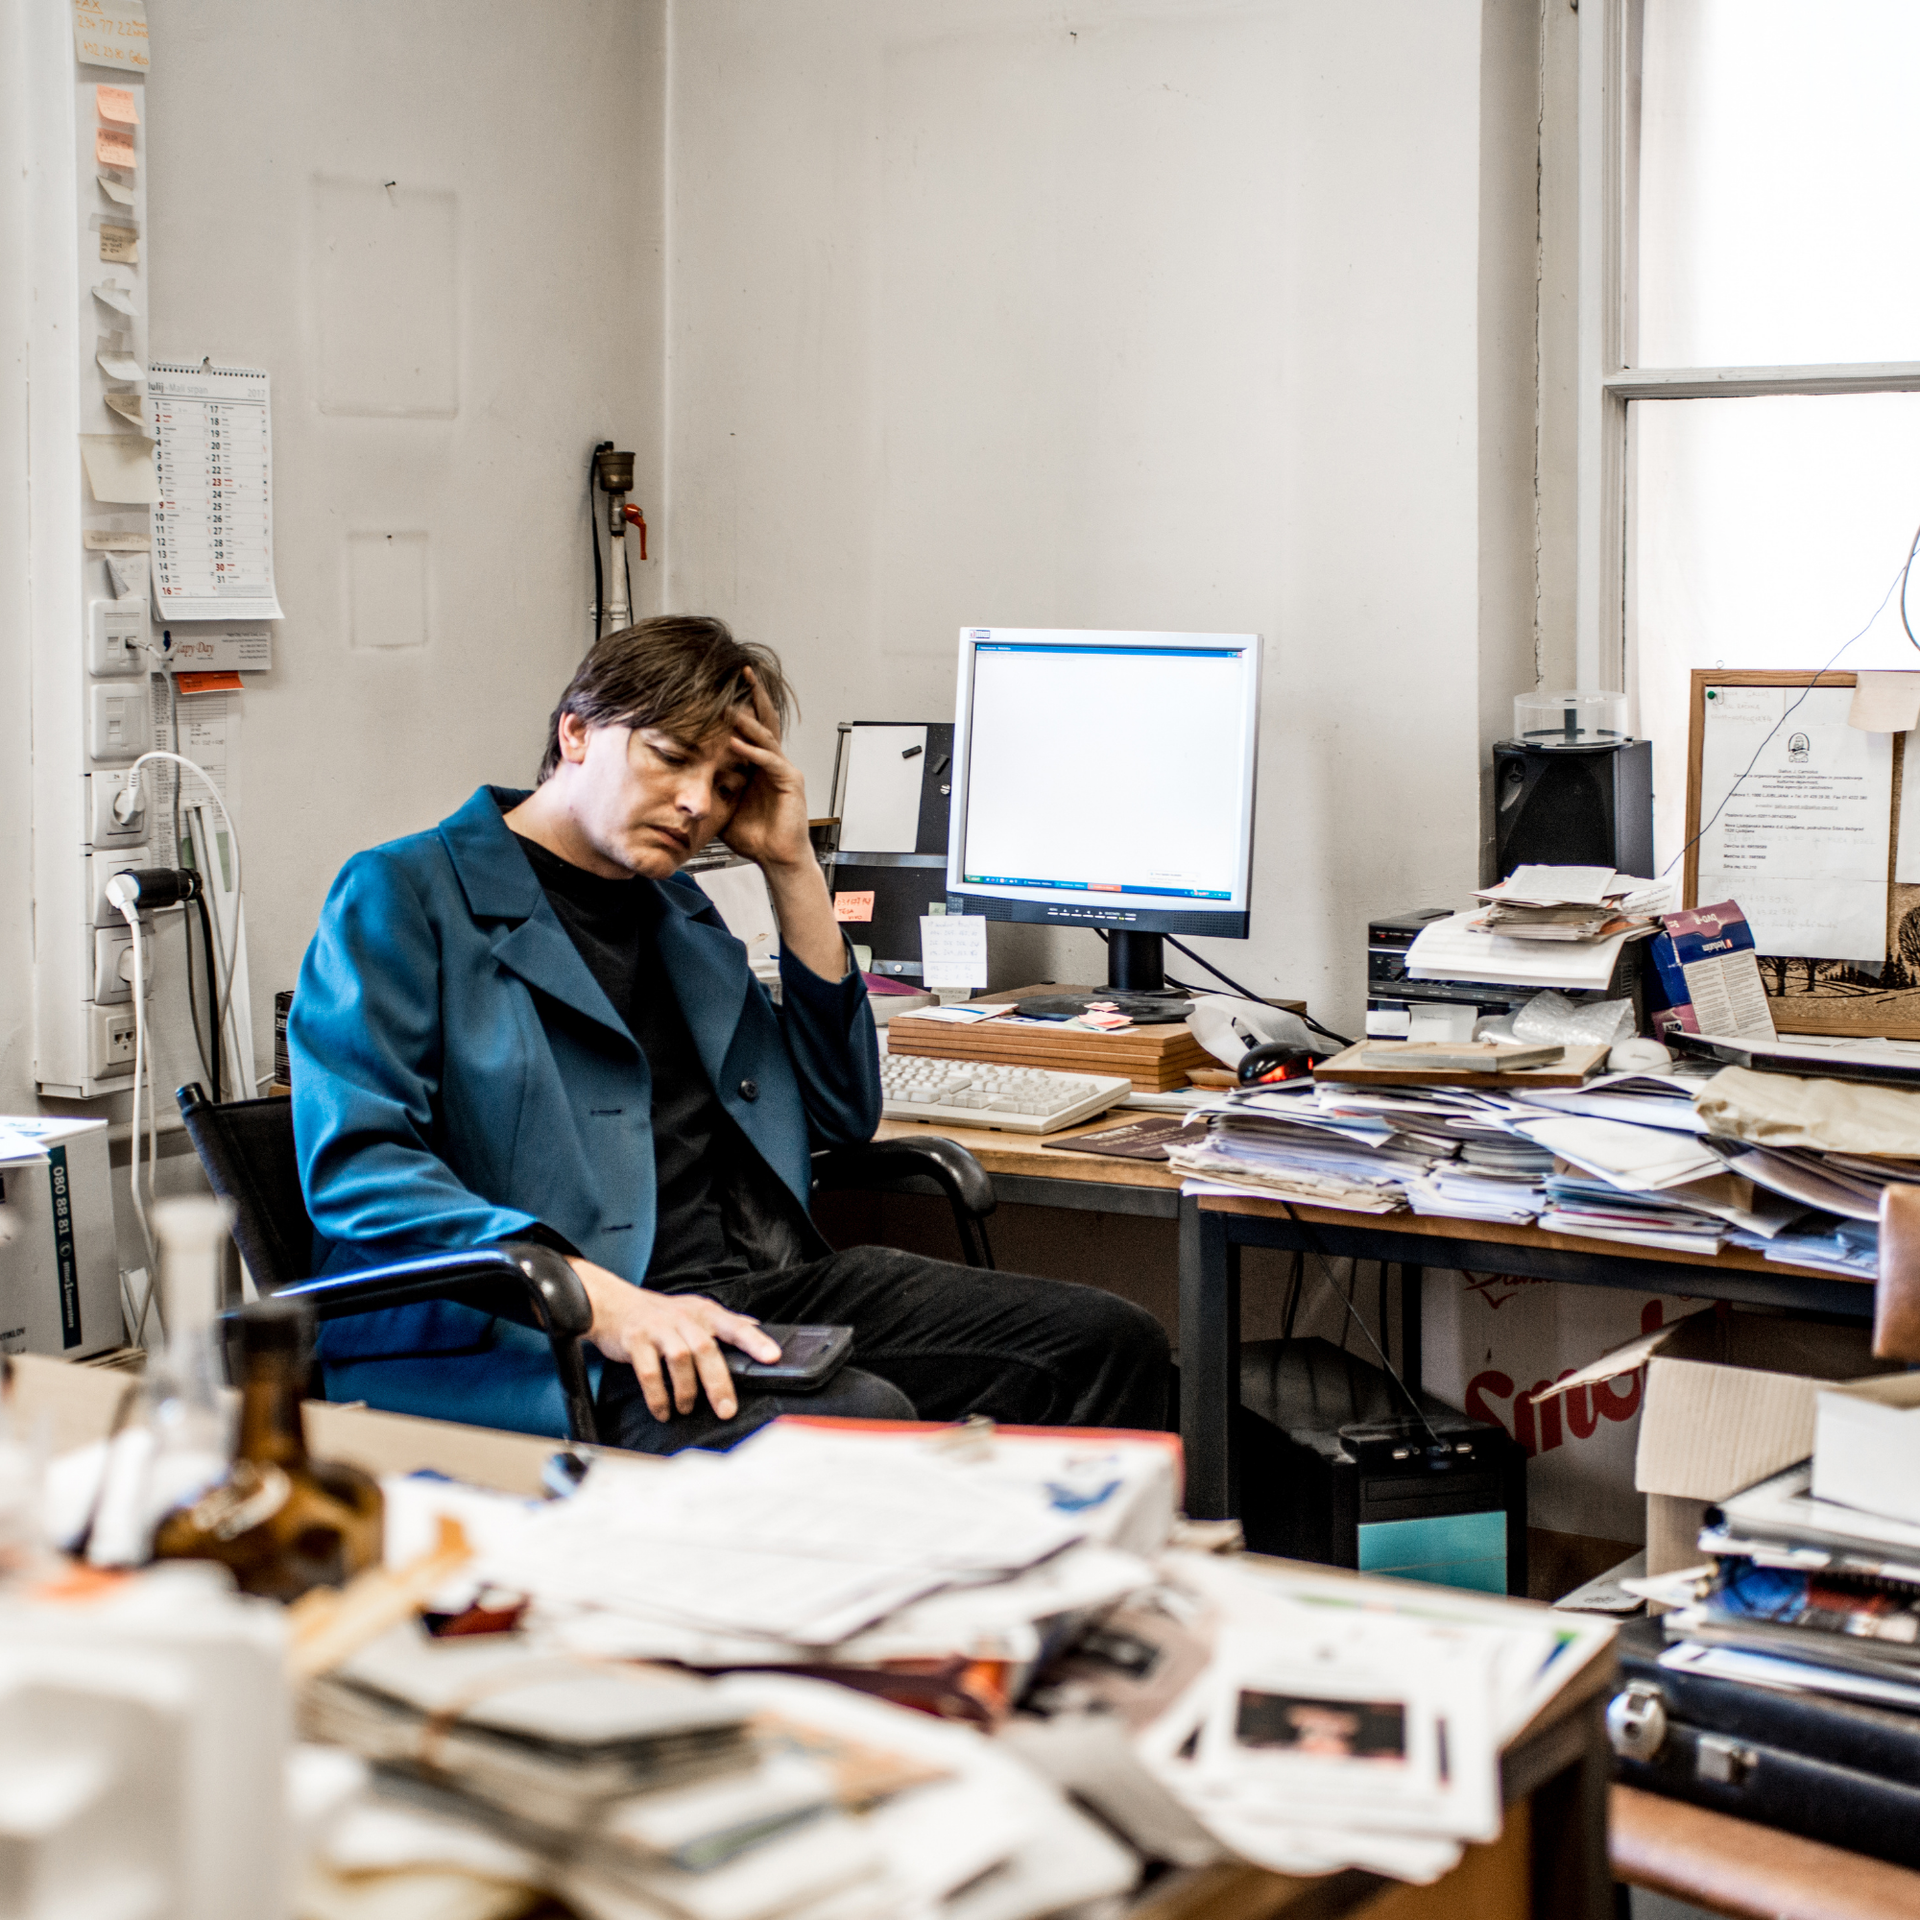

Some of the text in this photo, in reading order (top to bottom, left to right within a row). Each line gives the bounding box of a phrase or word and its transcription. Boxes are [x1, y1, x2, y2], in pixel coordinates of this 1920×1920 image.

[247, 389, 265, 398] 2017
[155, 401, 160, 410] 1
[210, 405, 219, 413] 17
[155, 413, 161, 423] 2
[210, 418, 220, 426] 18
[156, 426, 161, 435] 3
[211, 430, 220, 438] 19
[211, 442, 220, 450] 20
[157, 451, 162, 460] 5
[211, 454, 220, 462] 21
[157, 464, 163, 472] 6
[212, 466, 221, 475] 22
[212, 478, 222, 487] 23
[212, 490, 222, 499] 24
[159, 501, 164, 509] 9
[212, 503, 222, 511] 25
[155, 513, 165, 522] 10
[213, 515, 222, 523] 26
[155, 525, 165, 534] 11
[213, 527, 222, 535] 27
[156, 538, 166, 546] 12
[214, 539, 223, 547] 28
[157, 550, 167, 559] 13
[215, 551, 224, 560] 29
[159, 562, 168, 571] 14
[215, 563, 225, 572] 30
[160, 575, 169, 583] 15
[217, 575, 226, 584] 31
[162, 587, 172, 596] 16
[196, 641, 215, 656] Day
[1694, 913, 1718, 925] DVD-R
[1702, 940, 1727, 952] Verbatim
[53, 1166, 70, 1236] 080 88 81
